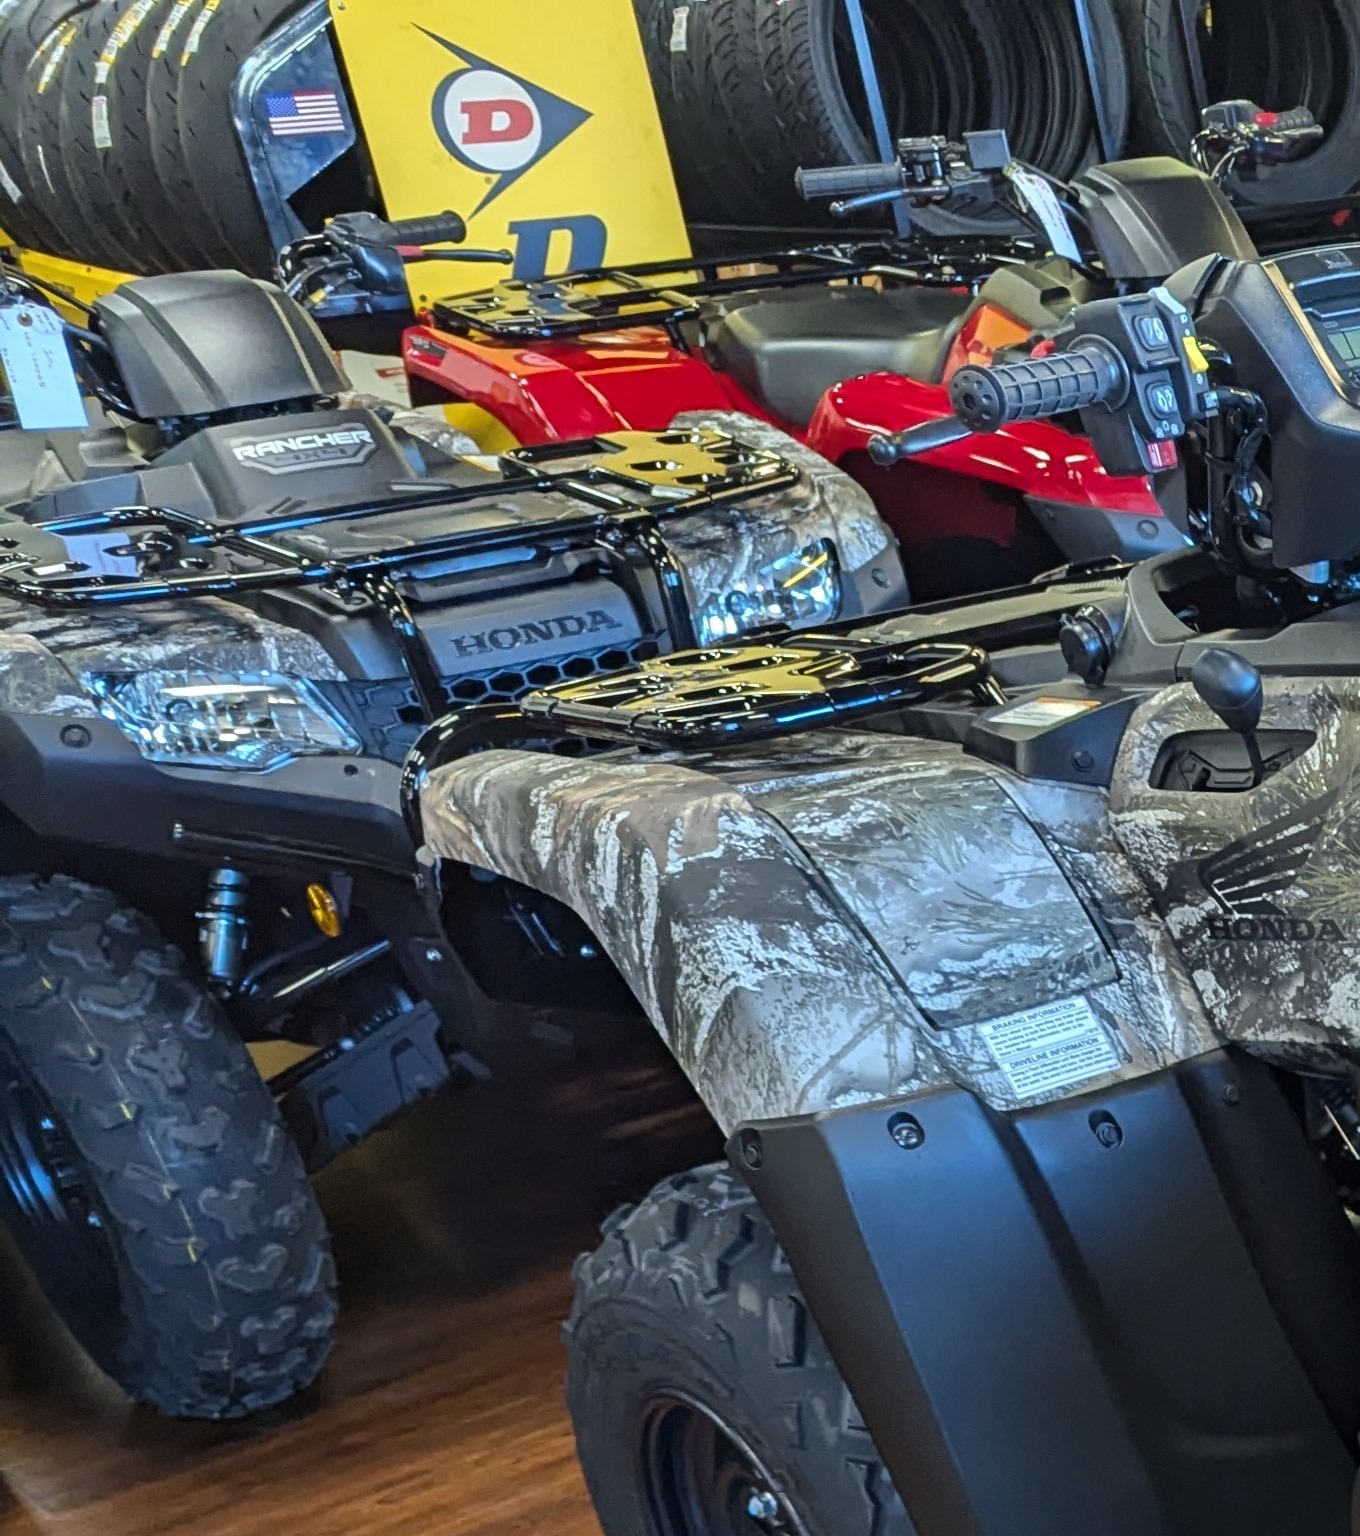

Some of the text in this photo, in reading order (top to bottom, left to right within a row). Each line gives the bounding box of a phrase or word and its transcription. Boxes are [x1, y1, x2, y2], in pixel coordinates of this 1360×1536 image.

[460, 99, 535, 145] D
[232, 430, 375, 461] RANCHER
[450, 609, 623, 656] HONDA
[1204, 917, 1348, 941] HONDA
[991, 1002, 1076, 1032] BRAKING INFORMATION
[1009, 1053, 1048, 1069] DRIVELINE
[1049, 1037, 1099, 1056] INFORMATION
